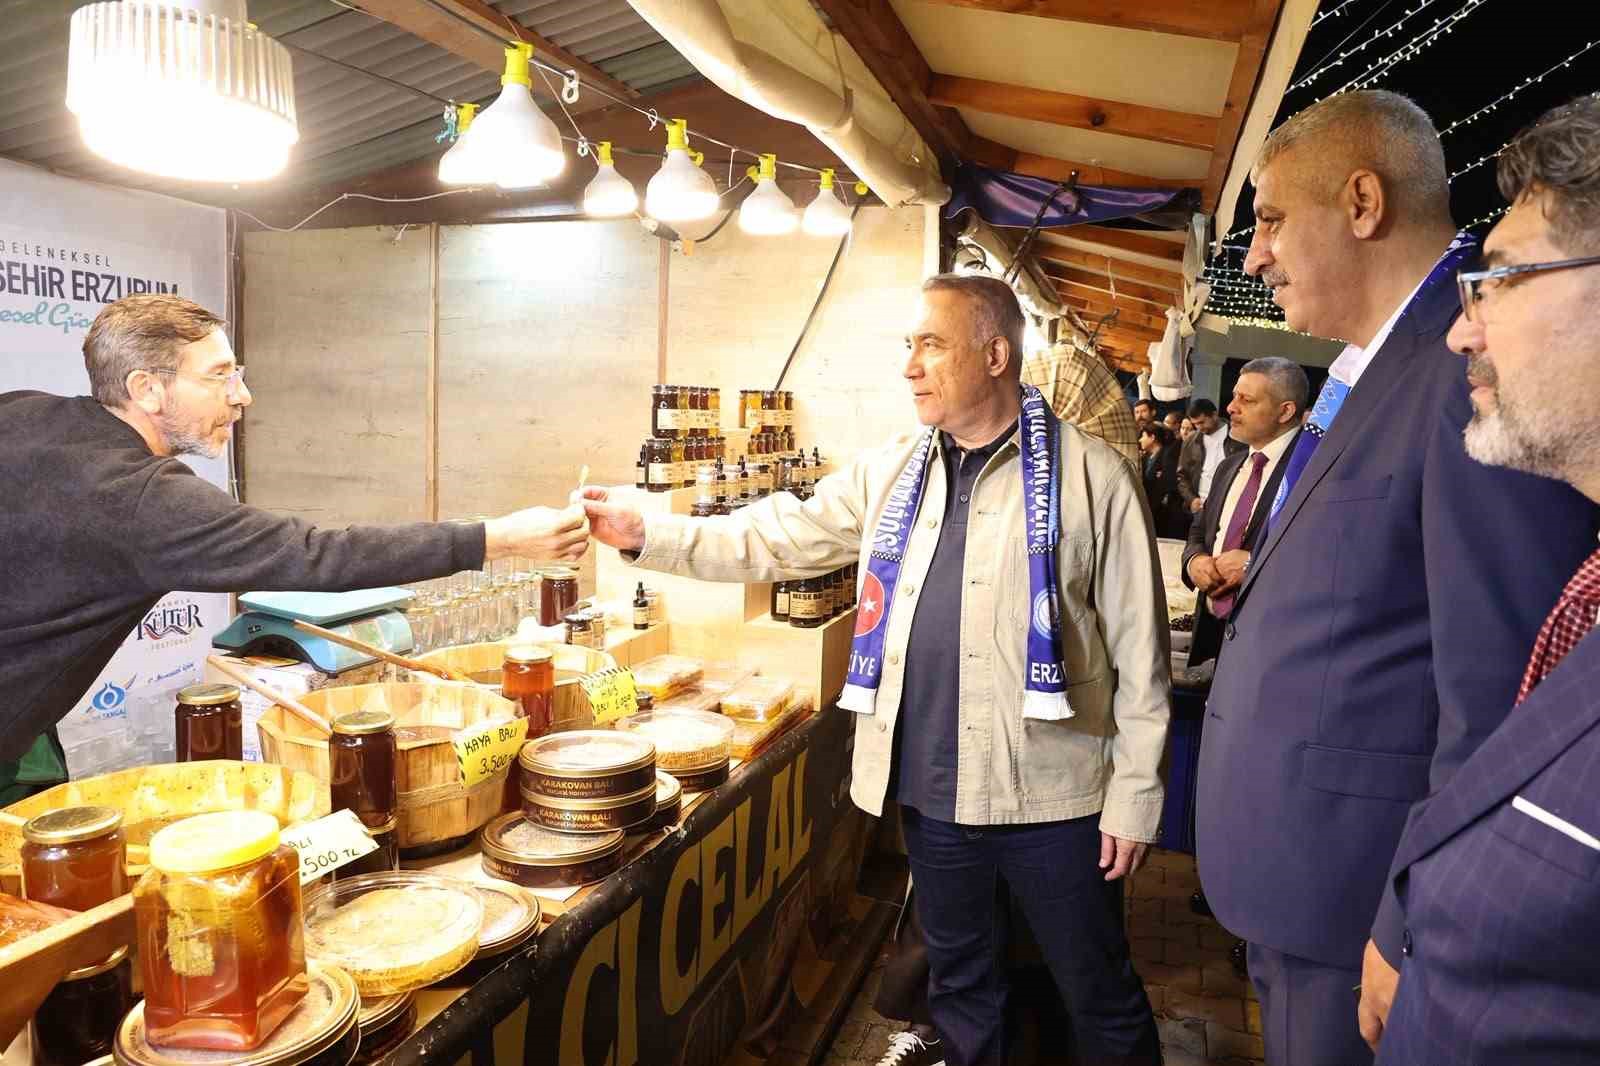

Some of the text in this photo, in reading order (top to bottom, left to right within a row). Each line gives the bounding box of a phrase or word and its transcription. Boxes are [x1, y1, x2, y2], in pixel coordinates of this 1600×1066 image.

[137, 604, 204, 641] KÜLTÜR
[848, 649, 876, 677] İYE
[464, 727, 518, 756] KAYA BALI
[541, 777, 593, 790] KARAKOVAN
[539, 809, 612, 822] KARAKOVAN BALI
[342, 848, 361, 858] TL
[659, 749, 814, 1016] CELAL
